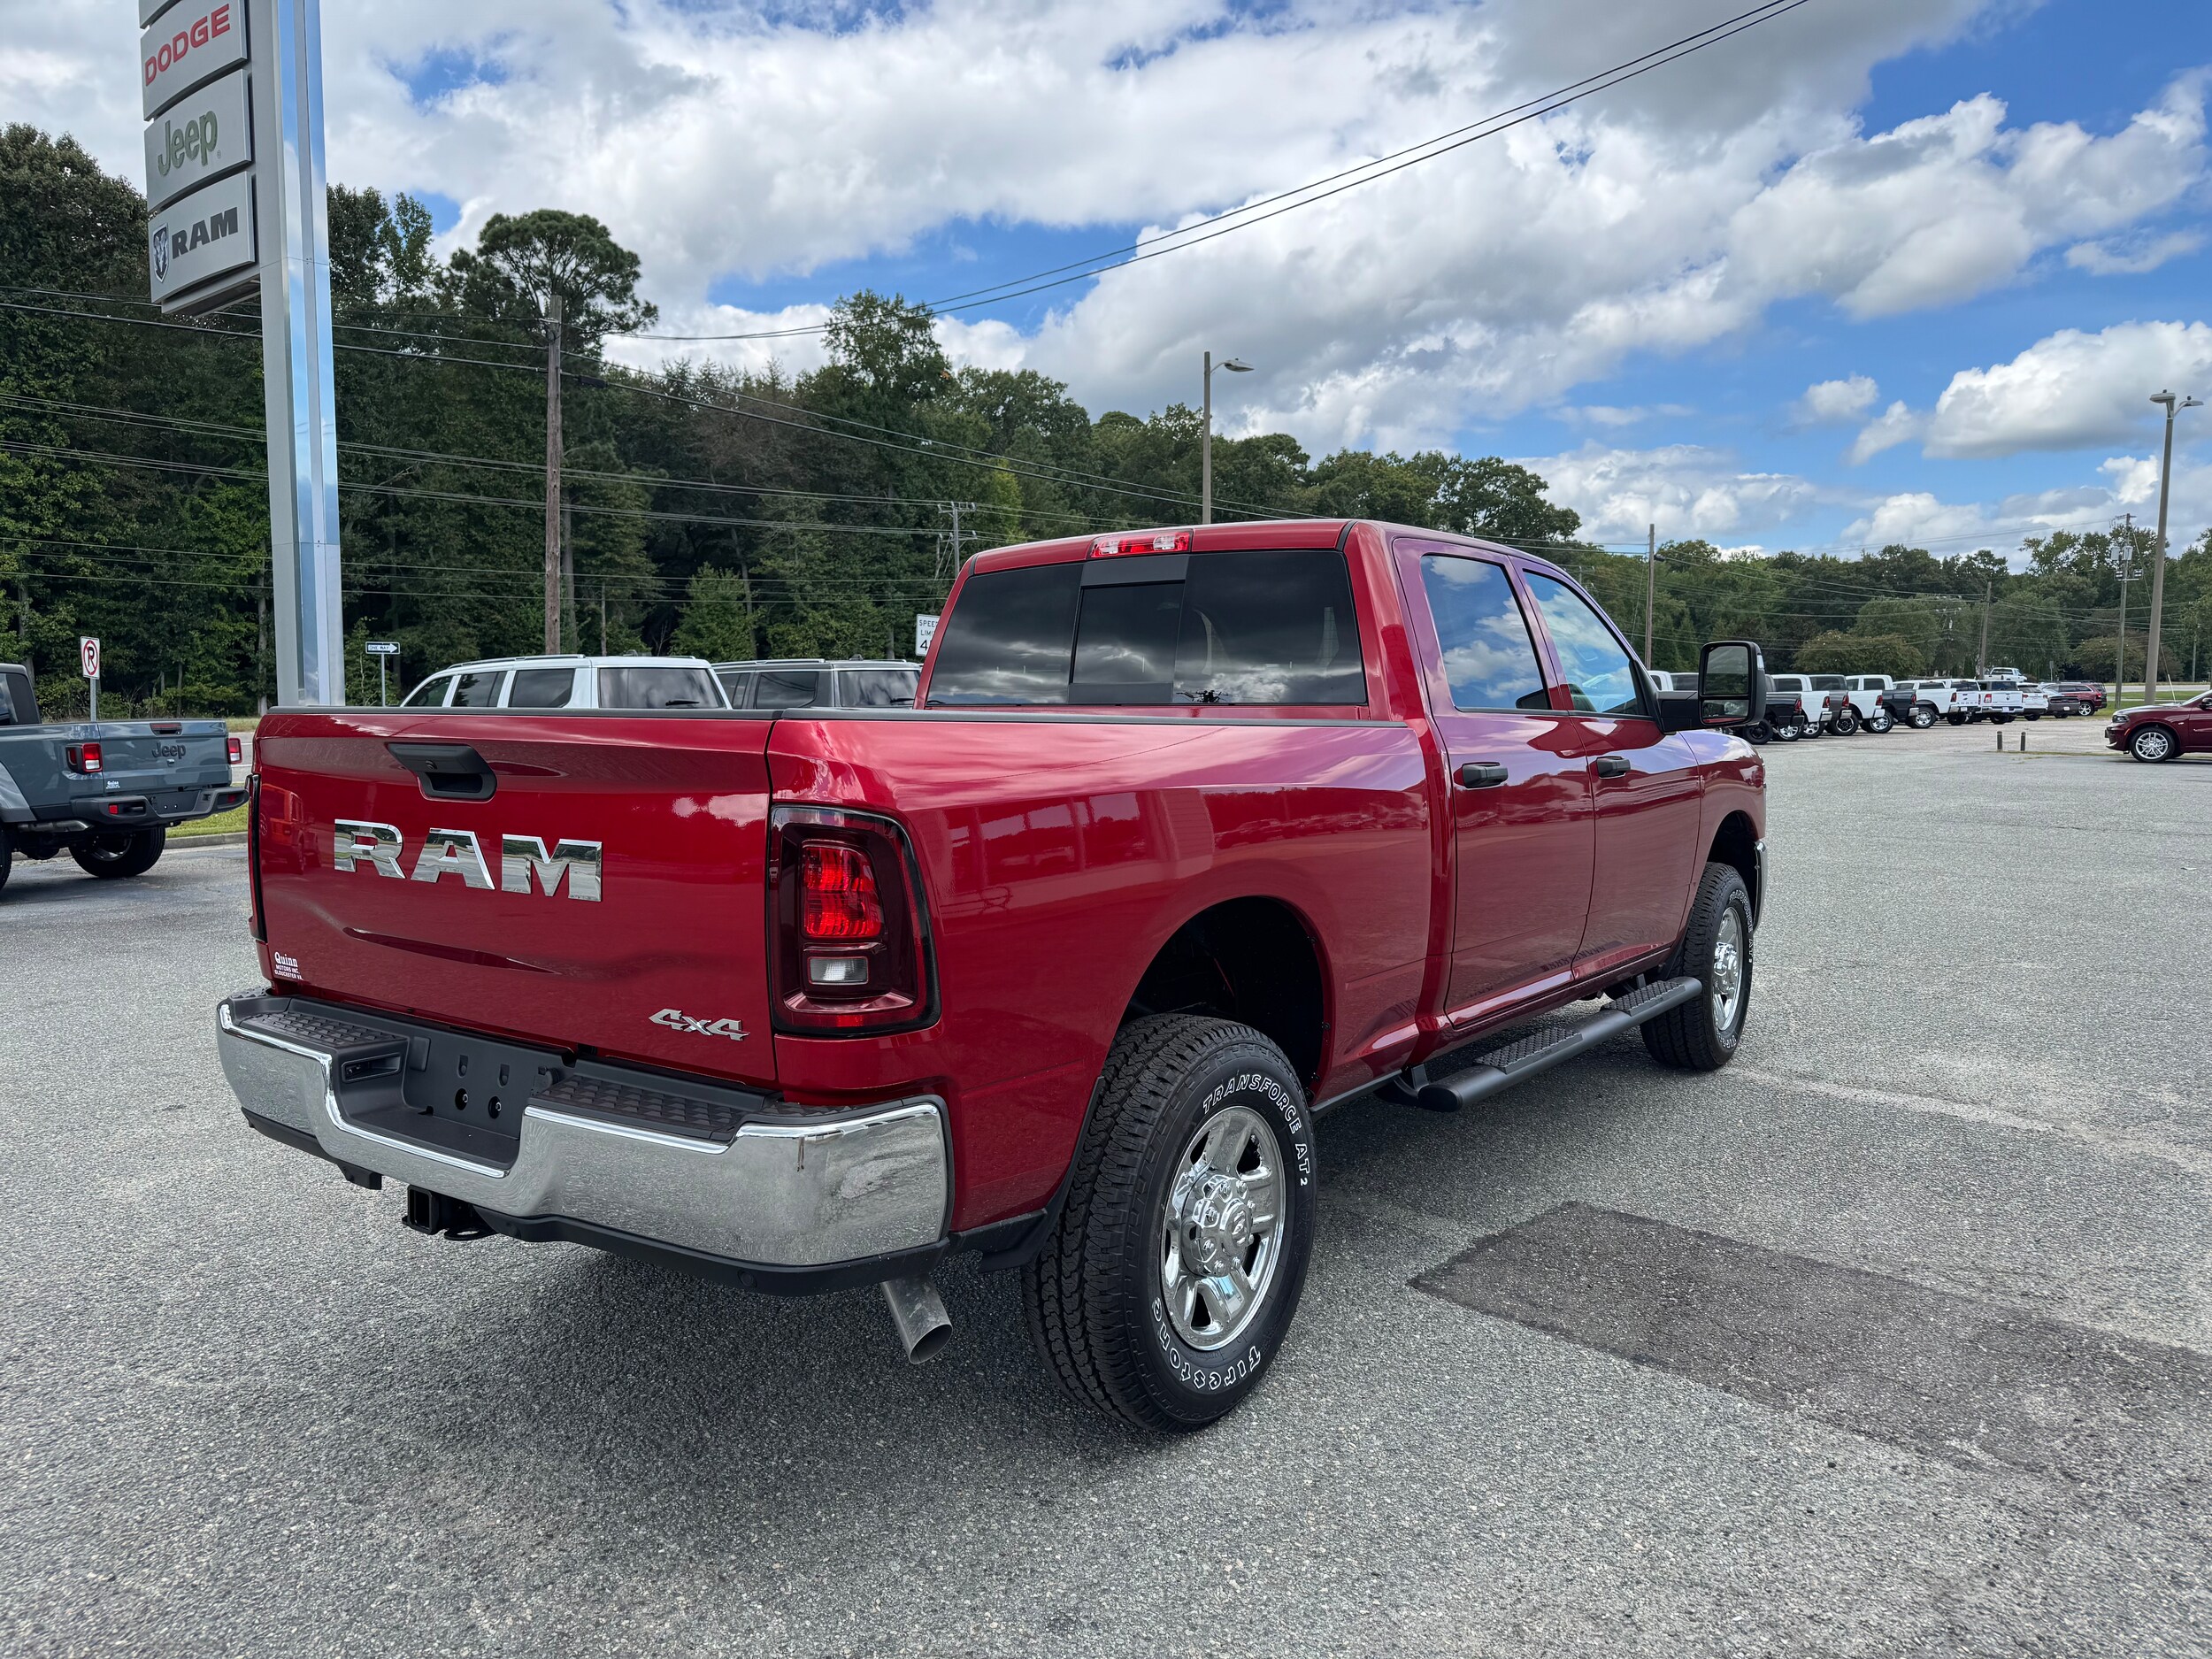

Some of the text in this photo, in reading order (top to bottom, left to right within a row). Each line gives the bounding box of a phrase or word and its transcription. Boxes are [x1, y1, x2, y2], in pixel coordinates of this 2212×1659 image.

[144, 4, 231, 87] DODGE
[157, 110, 219, 177] Jeep
[172, 206, 238, 259] RAM
[151, 741, 187, 759] Jeep
[334, 818, 603, 902] RAM
[274, 951, 298, 968] Quinn
[1202, 1073, 1302, 1134] TRANSFORCE
[1152, 1297, 1261, 1390] Firestone
